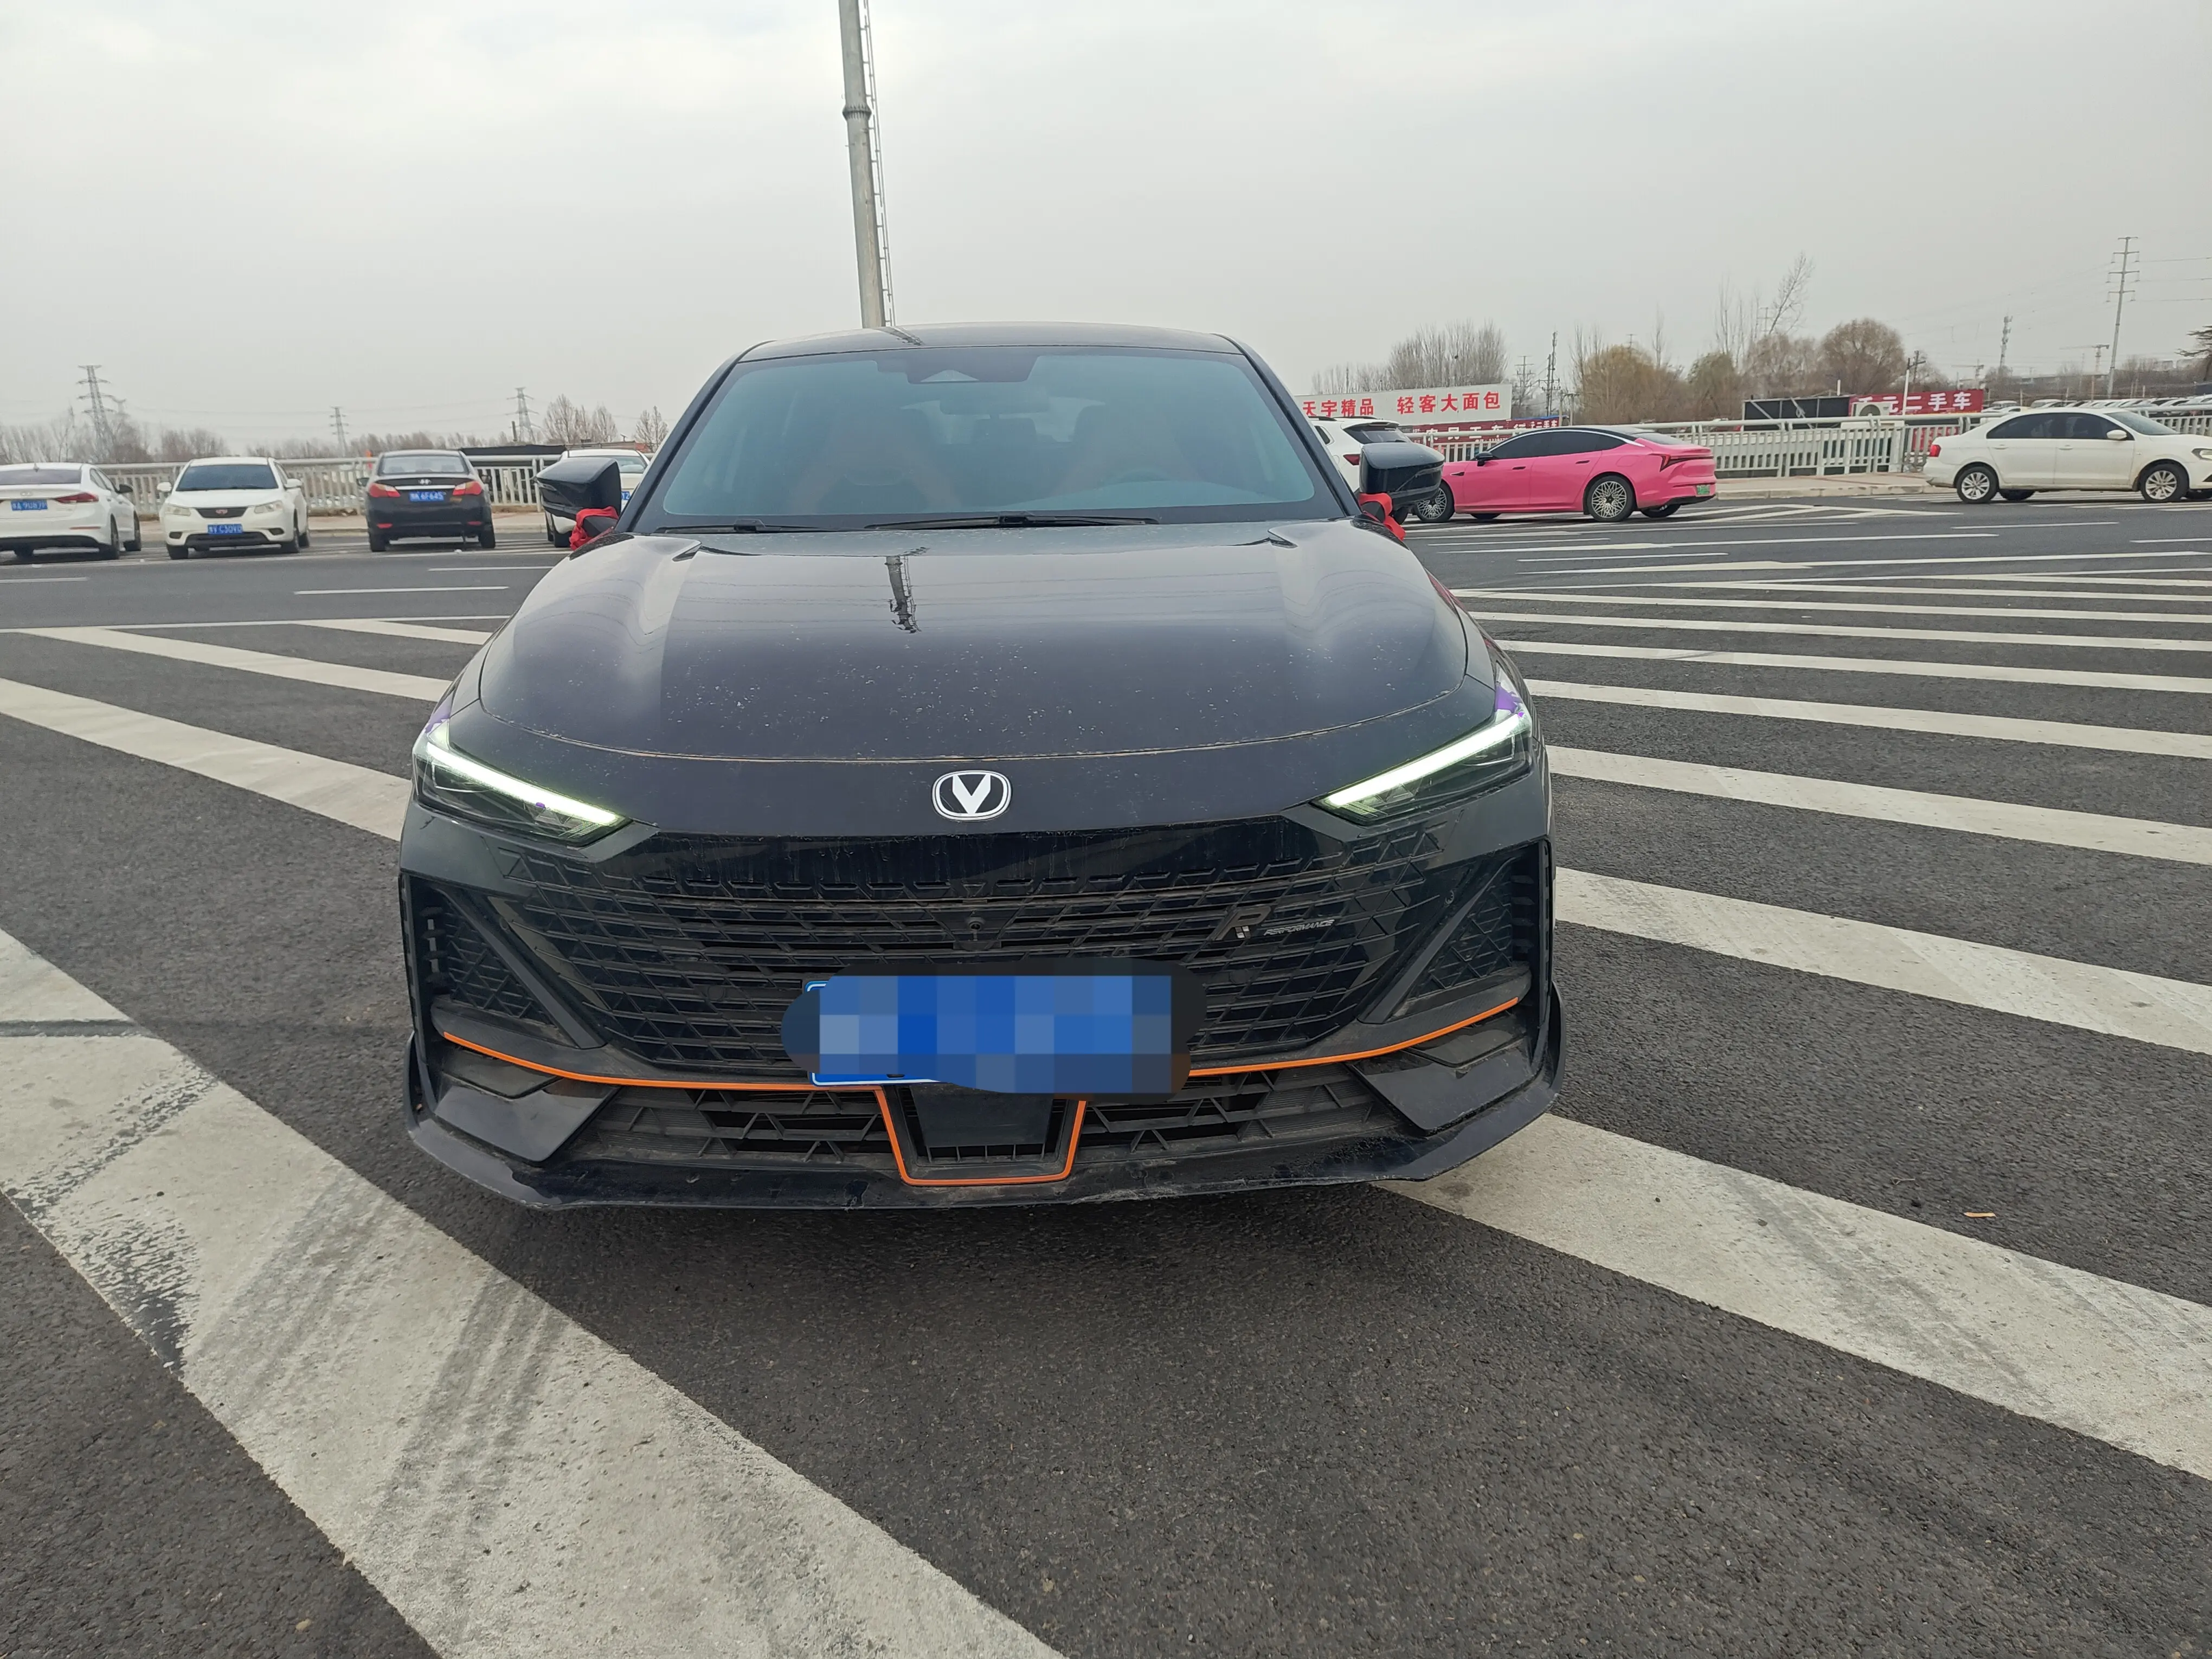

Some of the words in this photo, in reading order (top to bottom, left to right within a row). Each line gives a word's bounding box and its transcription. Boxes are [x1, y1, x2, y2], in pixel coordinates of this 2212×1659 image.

[1302, 398, 1374, 417] 天宇精品
[1397, 391, 1501, 415] 轻客大面包
[1263, 918, 1335, 937] PERFORMANCE
